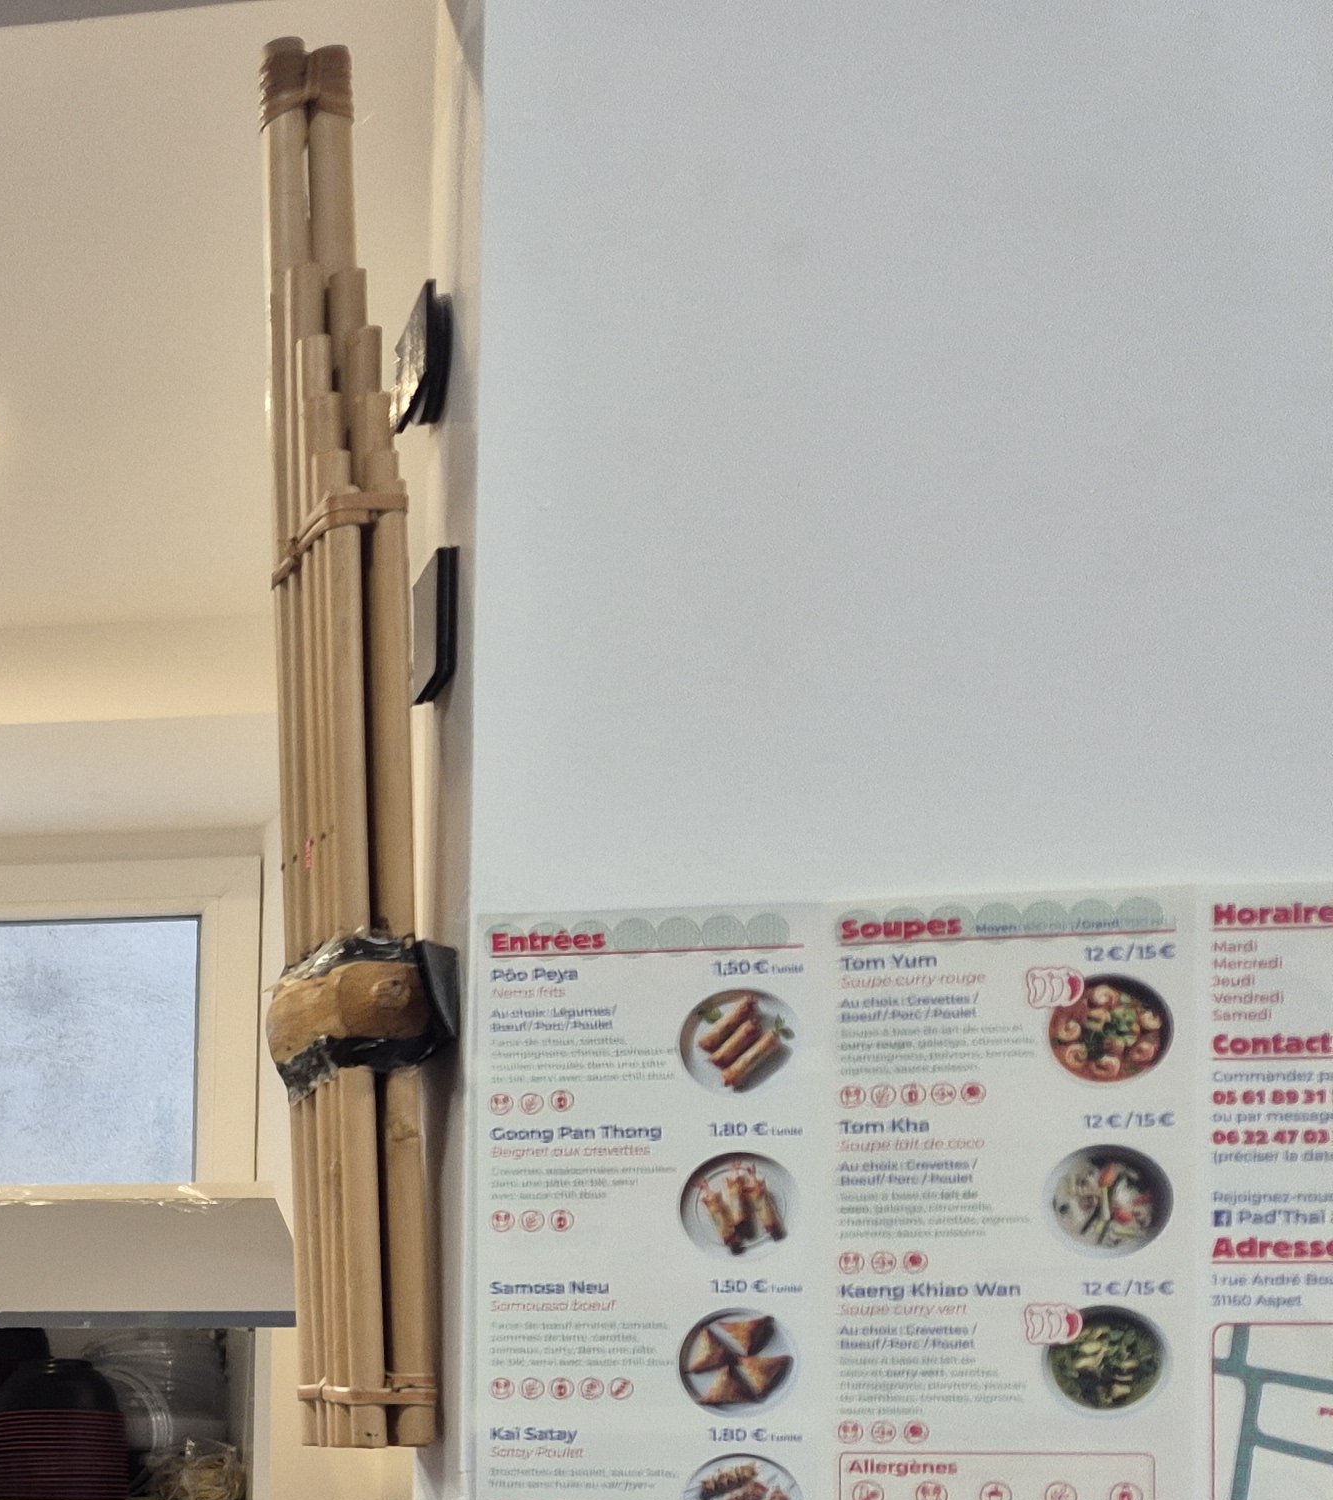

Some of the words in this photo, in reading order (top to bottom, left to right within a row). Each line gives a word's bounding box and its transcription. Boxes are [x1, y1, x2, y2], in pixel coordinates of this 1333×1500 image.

[1214, 902, 1333, 926] Horaire
[841, 918, 963, 940] Soupes
[491, 931, 607, 952] Entrées
[1214, 939, 1259, 952] Mardi
[840, 956, 885, 971] Tom
[891, 954, 938, 969] Yum
[1214, 956, 1283, 970] Mercredi
[939, 973, 986, 987] rouge
[1213, 974, 1256, 987] Jeudi
[1213, 989, 1284, 1004] Vendredi
[1213, 1008, 1272, 1022] Samedi
[839, 1119, 885, 1134] Tom
[891, 1117, 930, 1133] Kha
[1237, 1112, 1262, 1124] par
[600, 1124, 662, 1141] Thong
[1272, 1129, 1300, 1145] 47
[1252, 1273, 1301, 1286] André
[490, 1281, 565, 1294] Samosa
[840, 1283, 906, 1301] Kaeng
[911, 1281, 969, 1297] Khiao
[975, 1281, 1021, 1297] Wan
[1256, 1294, 1302, 1308] Aspet
[524, 1427, 578, 1444] Satay
